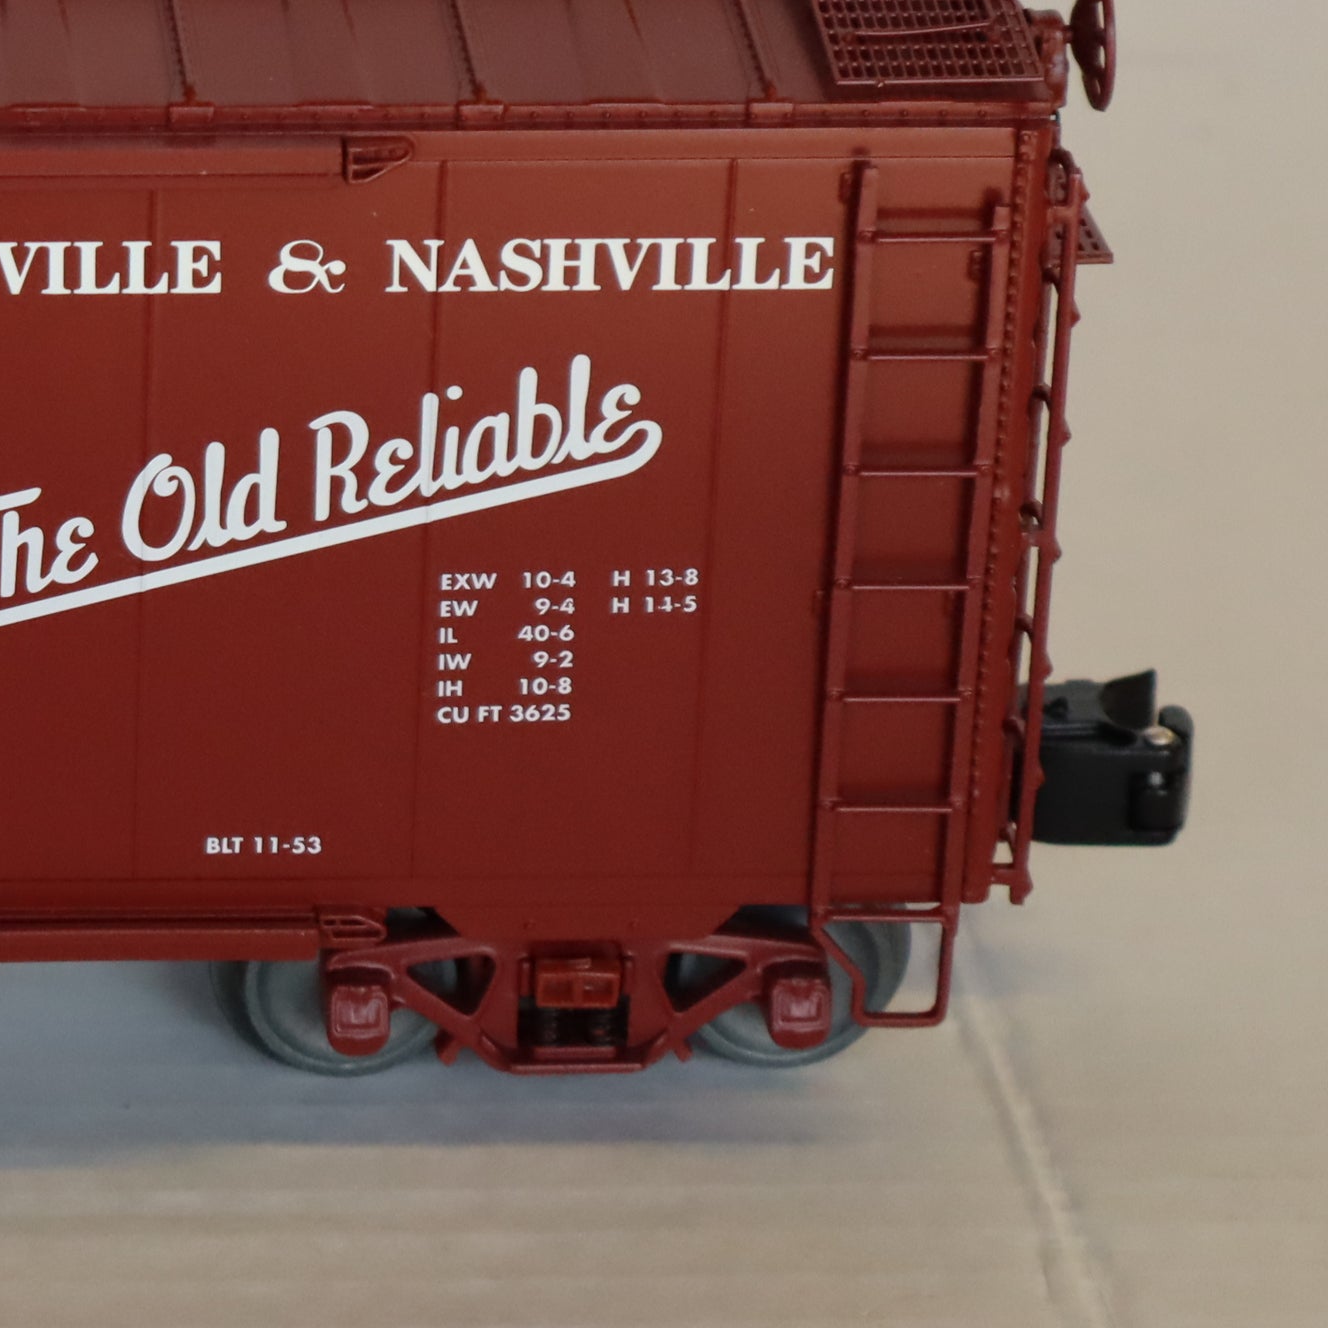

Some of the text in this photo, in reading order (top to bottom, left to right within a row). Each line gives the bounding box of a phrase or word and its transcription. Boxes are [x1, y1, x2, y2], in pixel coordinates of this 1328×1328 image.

[267, 239, 346, 294] &
[385, 236, 834, 293] NASHVILLE
[121, 428, 287, 562] Old
[308, 354, 662, 517] Reliable
[440, 568, 698, 590] EXW 10-4 H 13-8
[440, 595, 697, 617] EW 9-4 H 14-5
[439, 625, 574, 644] IL 40-6
[438, 650, 573, 670] IW 9-2
[438, 677, 572, 697] IH 10-8
[436, 704, 571, 723] CU FT 3625
[206, 836, 321, 854] BLT 11-53
